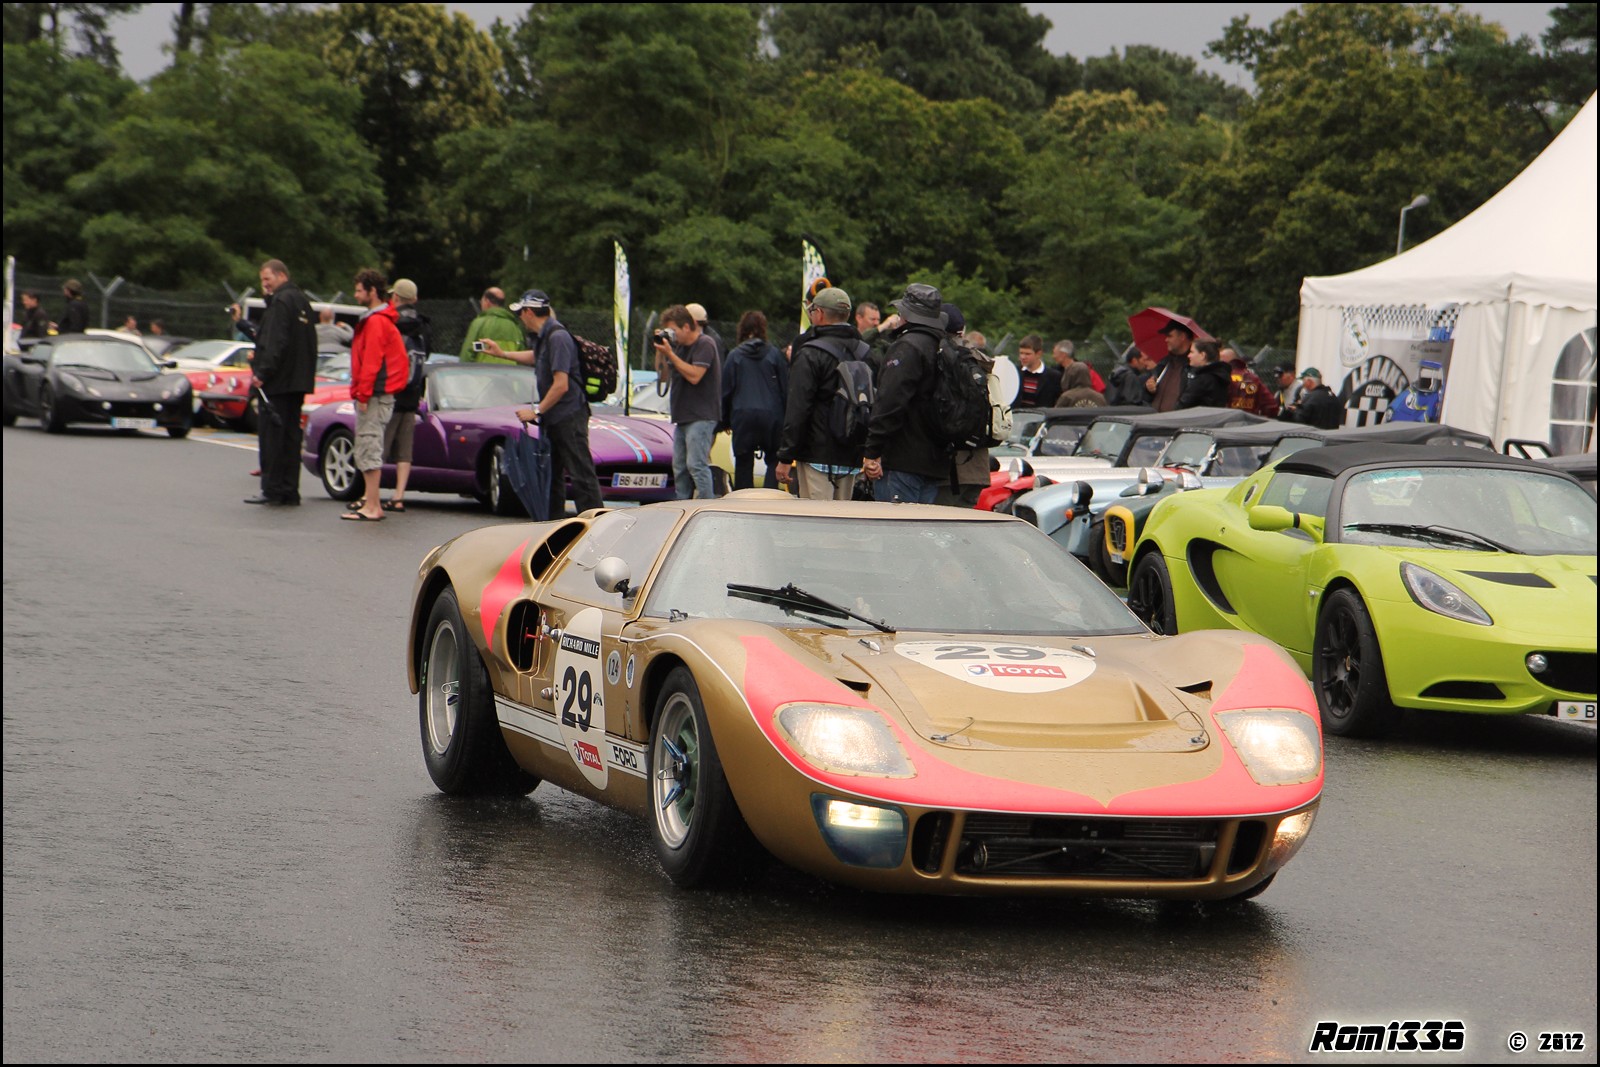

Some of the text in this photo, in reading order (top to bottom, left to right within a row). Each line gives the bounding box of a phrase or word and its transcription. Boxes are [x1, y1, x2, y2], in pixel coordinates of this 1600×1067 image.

[1365, 384, 1386, 397] CLASSIC
[561, 635, 599, 656] RICHARD MILLE
[934, 645, 1047, 661] 29
[607, 658, 619, 678] 124
[991, 665, 1064, 677] TOTAL
[562, 665, 592, 732] 29
[580, 745, 602, 766] TOTAL
[612, 745, 638, 769] FORD
